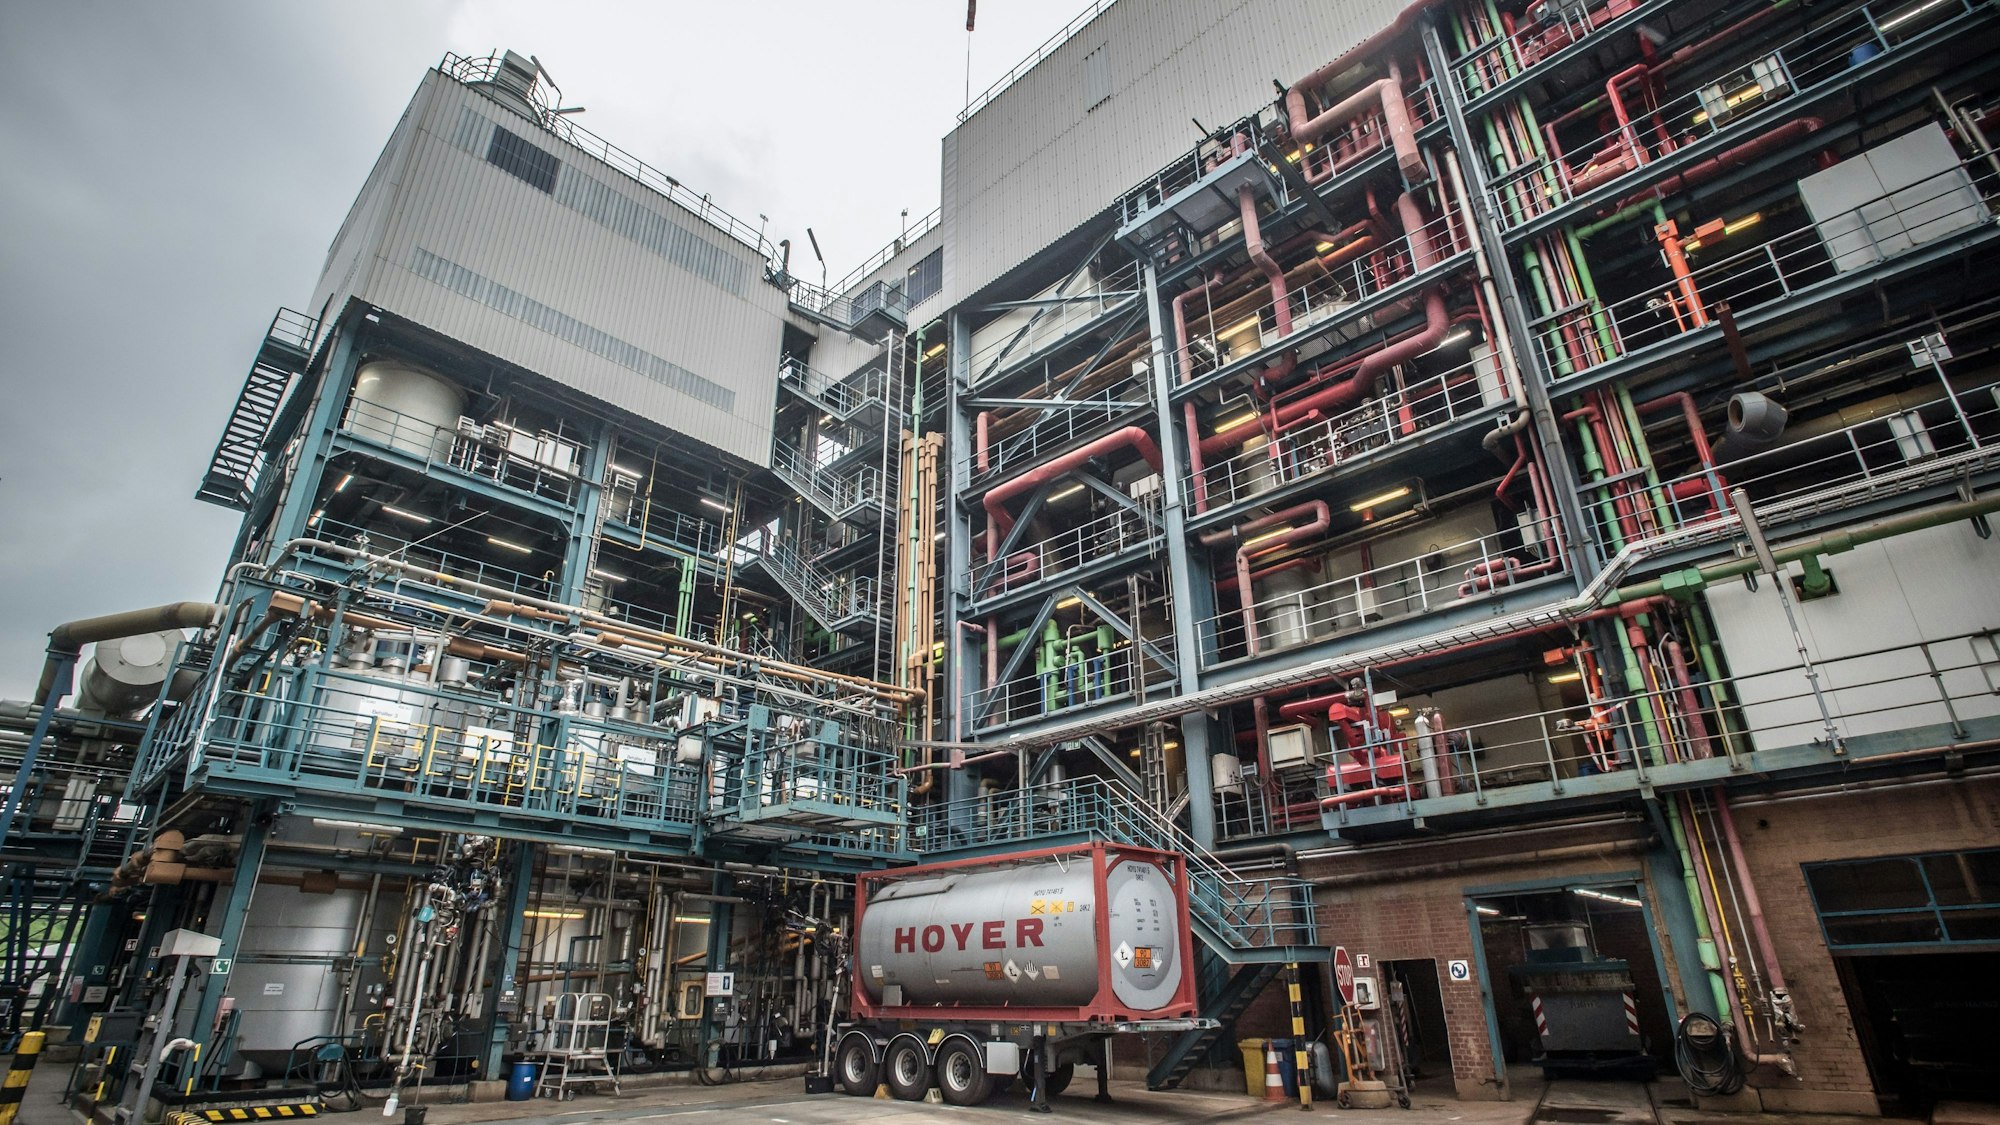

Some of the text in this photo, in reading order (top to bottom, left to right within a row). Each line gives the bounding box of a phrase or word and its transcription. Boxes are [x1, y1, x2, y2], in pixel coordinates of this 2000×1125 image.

[894, 918, 1045, 954] HOYER
[1140, 950, 1147, 958] 90
[1135, 959, 1150, 967] 3082
[1337, 964, 1352, 986] STOP
